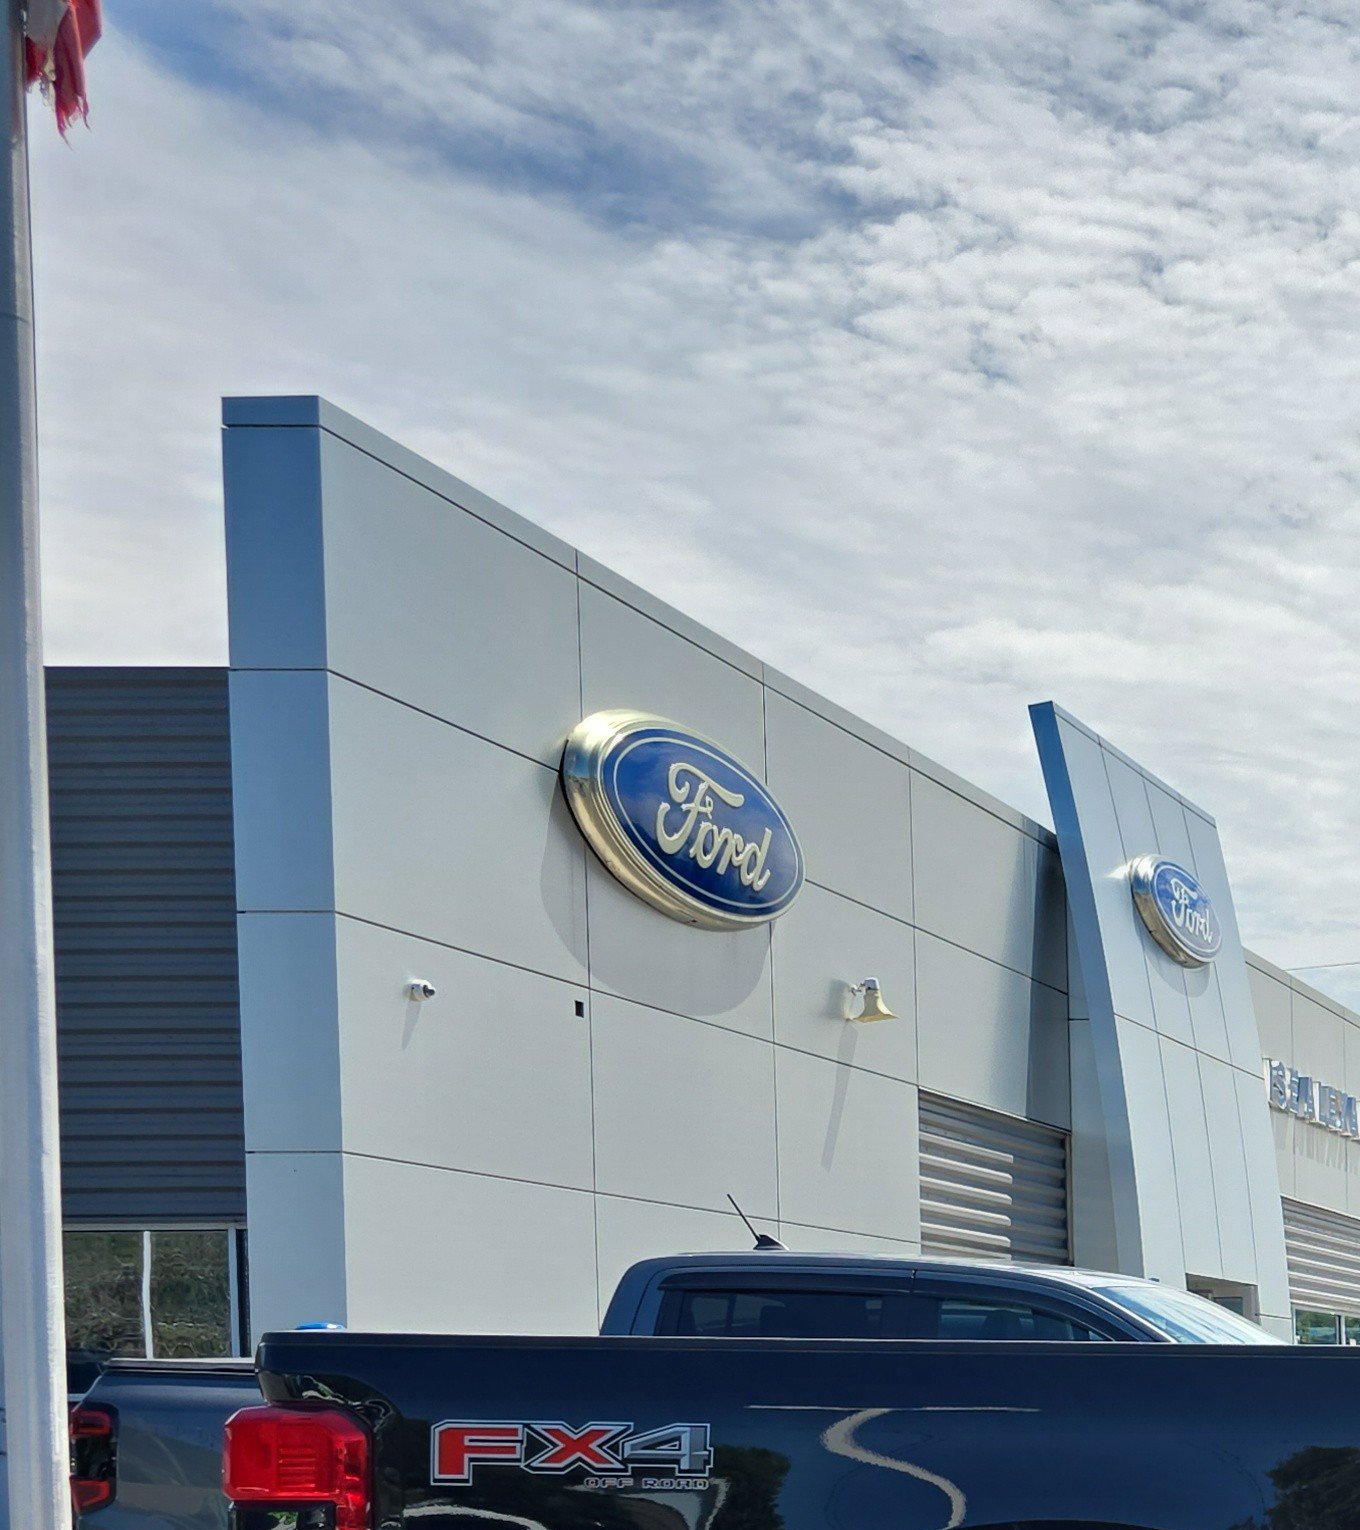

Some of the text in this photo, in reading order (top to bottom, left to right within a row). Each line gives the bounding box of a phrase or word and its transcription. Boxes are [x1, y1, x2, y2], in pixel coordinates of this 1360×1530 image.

[656, 762, 773, 892] Ford
[1170, 877, 1214, 944] Ford
[430, 1420, 715, 1486] FX4
[583, 1477, 711, 1490] OFF ROAD
